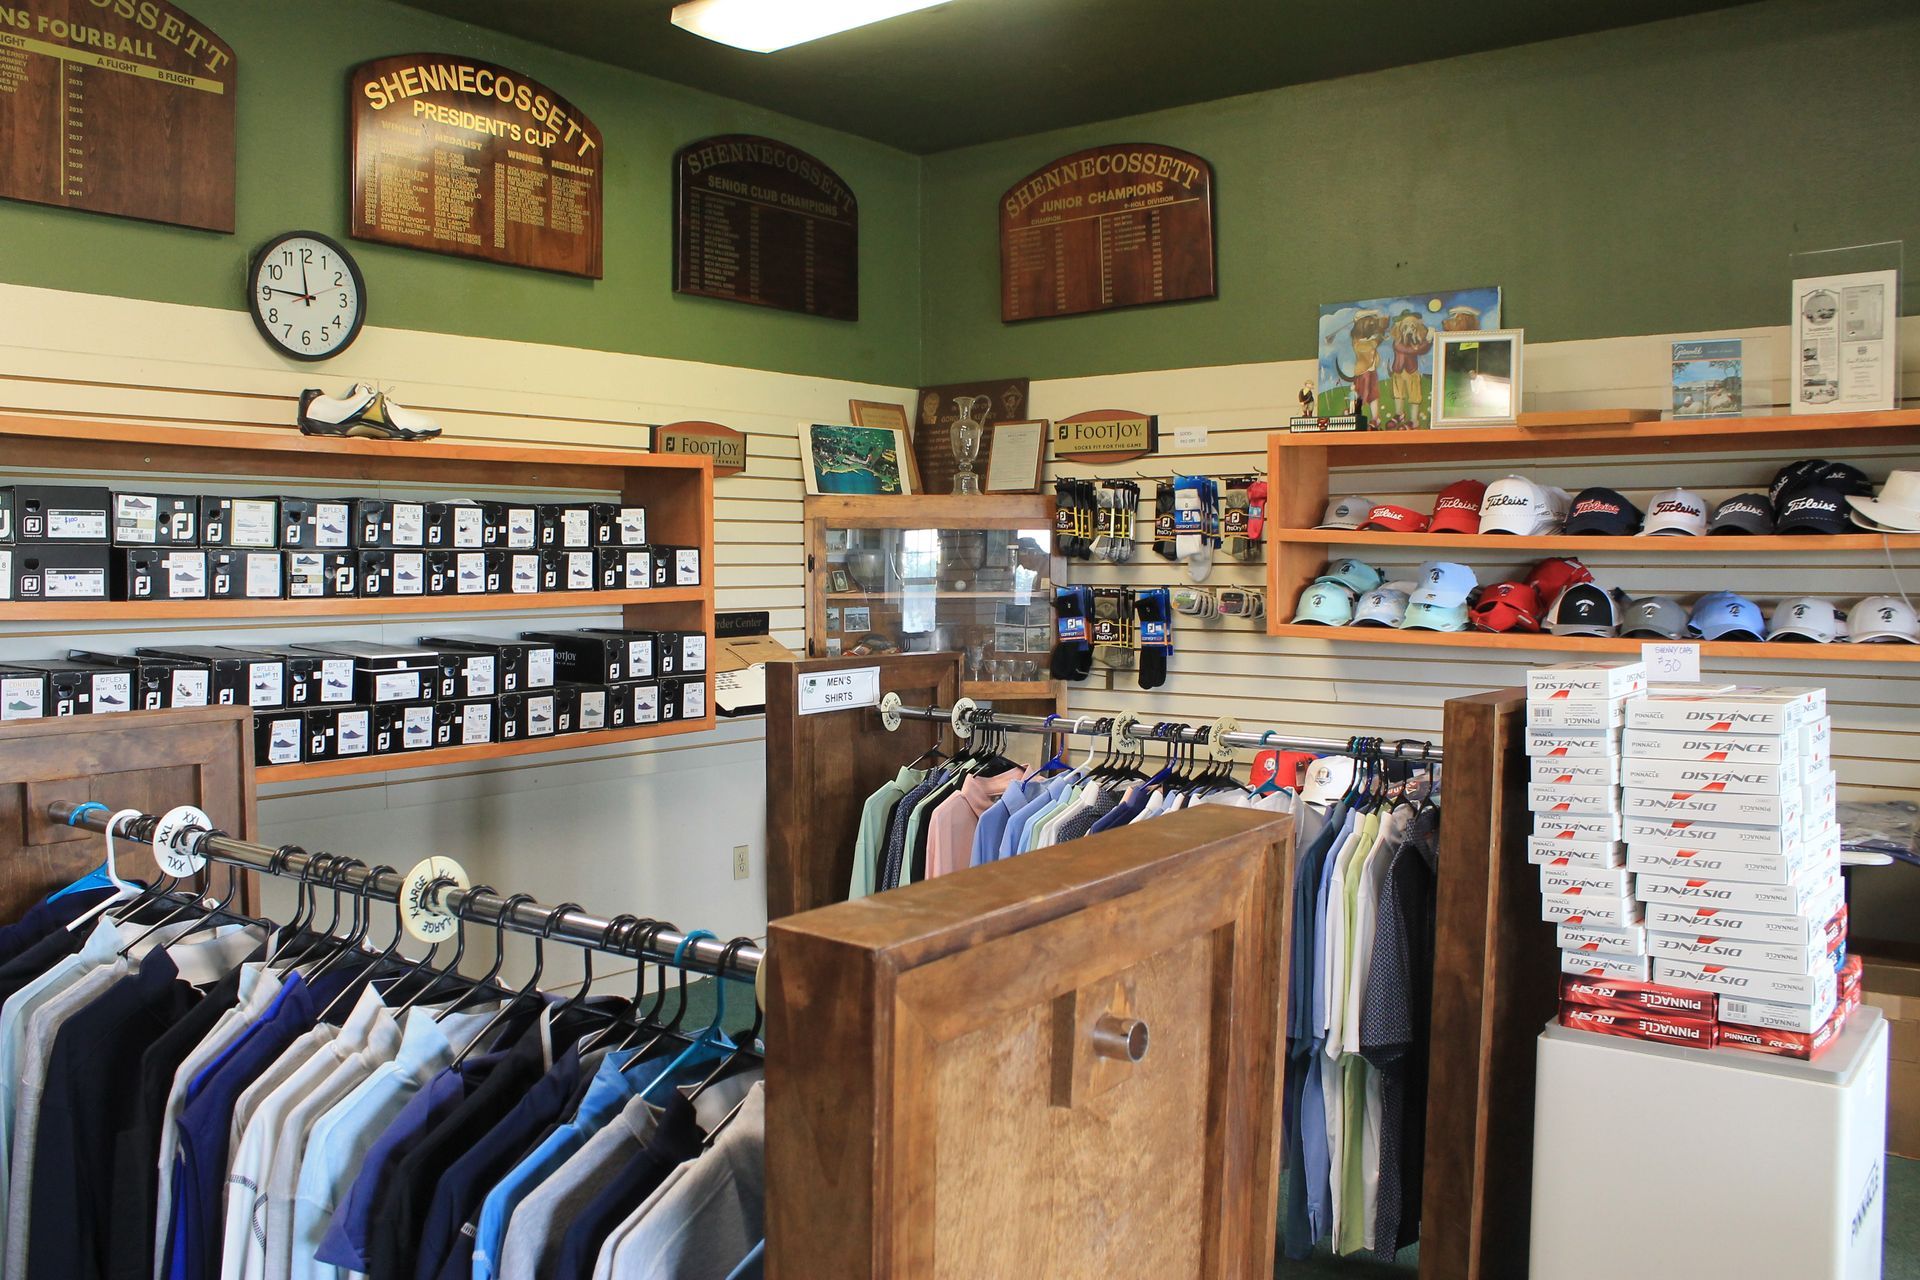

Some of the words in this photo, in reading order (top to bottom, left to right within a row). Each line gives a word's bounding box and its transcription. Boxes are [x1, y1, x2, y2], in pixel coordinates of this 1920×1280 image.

[38, 15, 157, 60] FOURBALL
[97, 57, 105, 66] A
[106, 59, 138, 73] FLIGHT
[158, 70, 164, 79] B
[165, 72, 196, 86] FLIGHT
[364, 64, 596, 158] SHENNECOSSETT
[382, 120, 422, 136] WINNER
[413, 99, 521, 141] PRESIDENT'S
[524, 127, 557, 149] CUP
[69, 133, 83, 142] 2037
[434, 133, 483, 151] MEDALIST
[507, 150, 544, 166] WINNER
[551, 160, 594, 177] MEDALIST
[687, 143, 855, 213] SHENNECOSSETT
[1006, 152, 1199, 218] SHENNECOSSETT
[708, 175, 748, 196] SENIOR
[751, 185, 778, 202] CLUB
[780, 193, 838, 217] CHAMPIONS
[1040, 196, 1082, 213] JUNIOR
[1088, 181, 1164, 205] CHAMPIONS
[1147, 195, 1174, 206] DIVISION
[282, 250, 293, 267] 11
[299, 248, 313, 264] 12
[321, 255, 327, 271] 1
[267, 264, 283, 280] 10
[334, 271, 343, 287] 2
[262, 285, 272, 301] 9
[339, 293, 348, 308] 3
[268, 308, 278, 324] 8
[332, 315, 341, 329] 4
[283, 324, 293, 339] 7
[301, 330, 311, 346] 6
[320, 326, 329, 342] 5
[1059, 425, 1068, 440] FJ
[666, 436, 675, 451] FJ
[1439, 497, 1479, 512] Titleist
[1487, 494, 1529, 510] Titleist
[1573, 499, 1620, 518] Titleist
[1653, 500, 1701, 517] Titleist
[1784, 497, 1838, 516] Titleist
[1373, 507, 1404, 522] Titleist
[1715, 502, 1764, 521] Titleist
[26, 519, 40, 532] FJ
[171, 512, 194, 540] FJ
[207, 522, 223, 541] FJ
[365, 525, 379, 542] FJ
[287, 525, 300, 543] FJ
[428, 526, 442, 543] FJ
[484, 526, 497, 543] FJ
[543, 527, 555, 543] FJ
[24, 577, 38, 591] FJ
[135, 575, 151, 596] FJ
[215, 574, 230, 594] FJ
[336, 566, 355, 592] FJ
[367, 574, 380, 592] FJ
[488, 573, 499, 591] FJ
[546, 571, 556, 588] FJ
[735, 617, 762, 628] Center
[664, 656, 674, 672] FJ
[1658, 656, 1682, 673] $30
[114, 683, 128, 691] 10.5
[195, 682, 202, 690] 11
[442, 678, 455, 696] FJ
[505, 673, 517, 690] FJ
[826, 675, 852, 687] MEN'S
[1535, 680, 1602, 690] DISTANCE
[26, 688, 41, 697] 10.5
[219, 688, 234, 706] FJ
[293, 683, 307, 702] FJ
[825, 692, 853, 703] SHIRTS
[146, 691, 162, 711] FJ
[1686, 710, 1774, 722] DISTANCE
[505, 720, 516, 738] FJ
[312, 735, 325, 755] FJ
[378, 732, 391, 750] FJ
[1533, 738, 1600, 747] DISTANCE
[1682, 740, 1770, 752] DISTANCE
[1538, 766, 1604, 775] DISTANCE
[1681, 770, 1769, 783] DISTANCE
[1536, 794, 1601, 803] DISTANCE
[1633, 799, 1717, 812] DISTANCE
[158, 823, 174, 846] XXL
[1541, 821, 1607, 832] DISTANCE
[1633, 826, 1717, 840] DISTANCE
[1535, 848, 1600, 860] DISTANCE
[1638, 855, 1722, 869] DISTANCE
[168, 855, 186, 872] XXL
[1548, 877, 1614, 889] DISTANCE
[409, 875, 428, 920] X-LARGE
[1647, 884, 1732, 899] DISTANCE
[1549, 906, 1615, 918] DISTANCE
[1657, 913, 1743, 928] DISTANCE
[1765, 923, 1799, 931] PINNACLE
[1564, 933, 1631, 946] DISTANCE
[1658, 940, 1742, 957] DISTANCE
[1569, 957, 1636, 972] DISTANCE
[1664, 968, 1748, 986] DISTANCE
[1571, 984, 1616, 997] RUSH
[1641, 993, 1701, 1010] PINNACLE
[1571, 1010, 1615, 1024] RUSH
[1760, 1016, 1800, 1027] PINNACLE
[1639, 1020, 1700, 1038] PINNACLE
[1724, 1032, 1762, 1044] PINNACLE
[1769, 1040, 1803, 1051] RUSH
